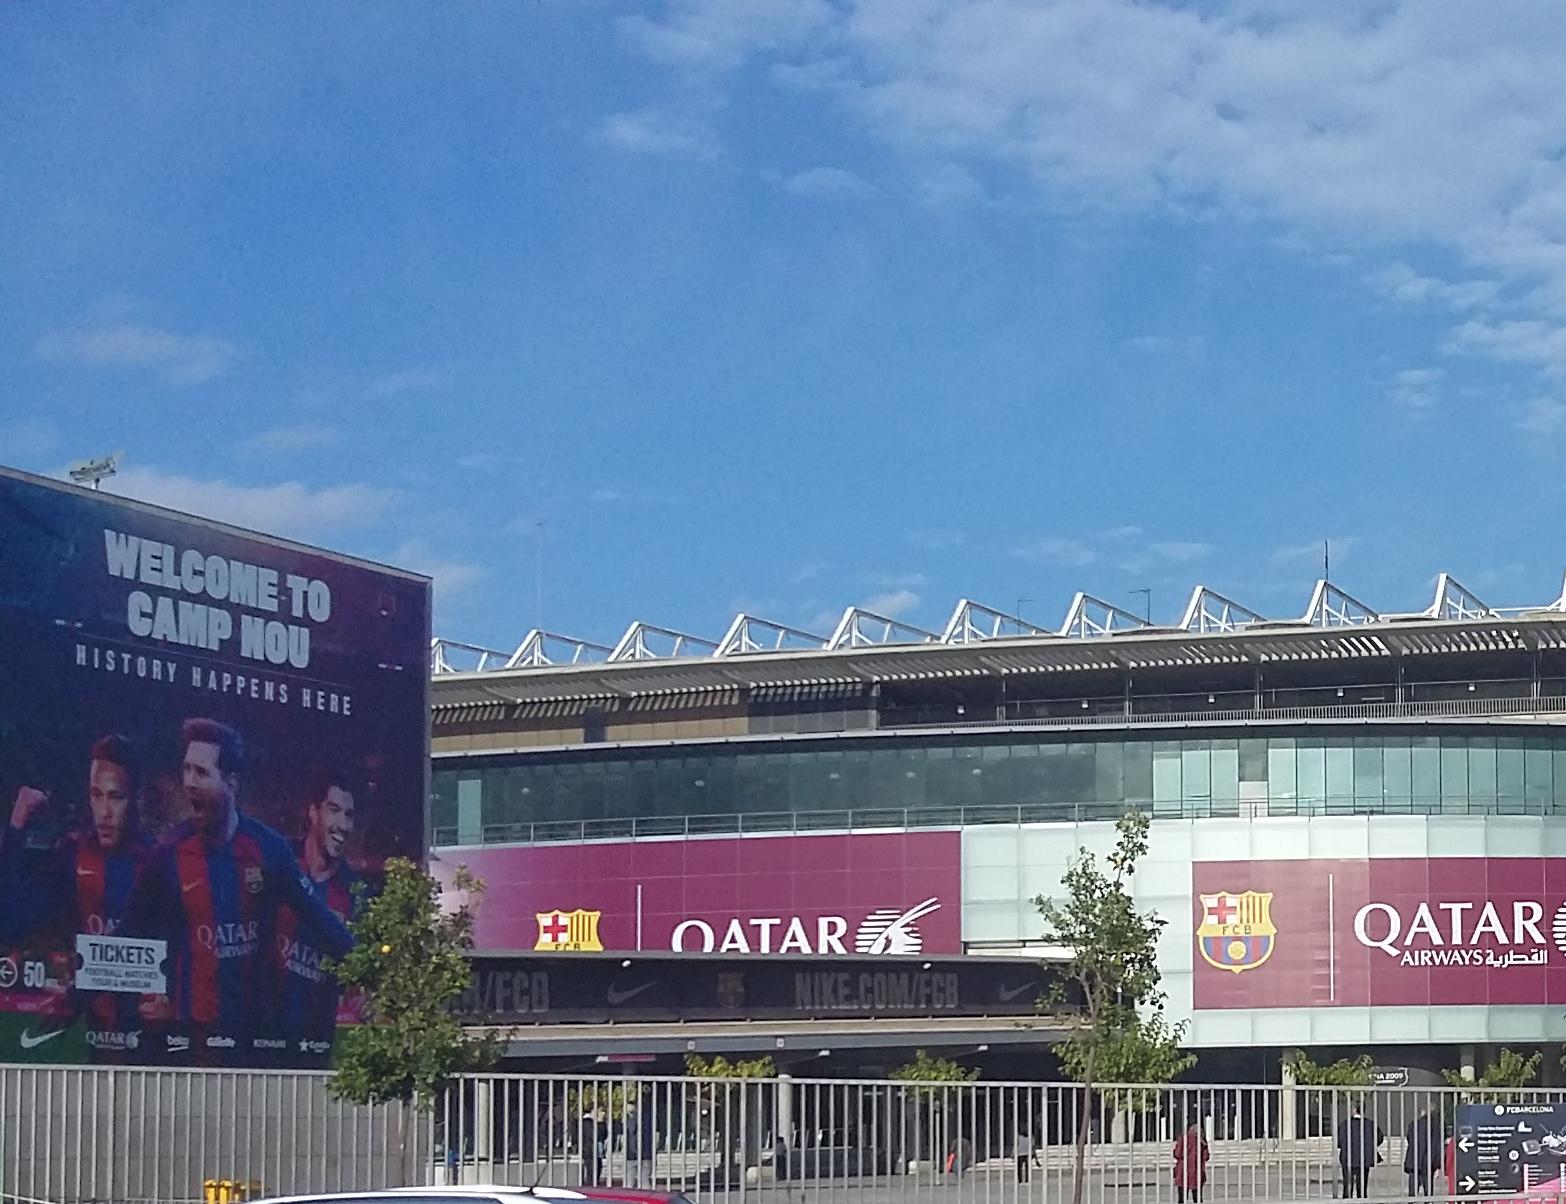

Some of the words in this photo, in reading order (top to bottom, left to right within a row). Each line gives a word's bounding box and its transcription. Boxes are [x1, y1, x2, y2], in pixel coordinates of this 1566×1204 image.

[105, 529, 278, 612] WELCOME
[286, 575, 331, 622] TO
[127, 591, 233, 651] CAMP
[241, 614, 310, 668] NOU
[76, 644, 176, 683] HISTORY
[192, 667, 288, 704] HAPPENS
[302, 688, 352, 716] HERE
[197, 921, 258, 949] QATAR
[1222, 925, 1252, 935] FCB
[1354, 901, 1547, 957] QATAR
[89, 943, 155, 965] TICKETS
[1400, 950, 1483, 967] AIRWAYS
[1485, 949, 1548, 968] القطرية
[24, 961, 45, 988] 50
[795, 972, 959, 1009] NIKE.COM/FCB
[86, 1030, 125, 1045] QATAR
